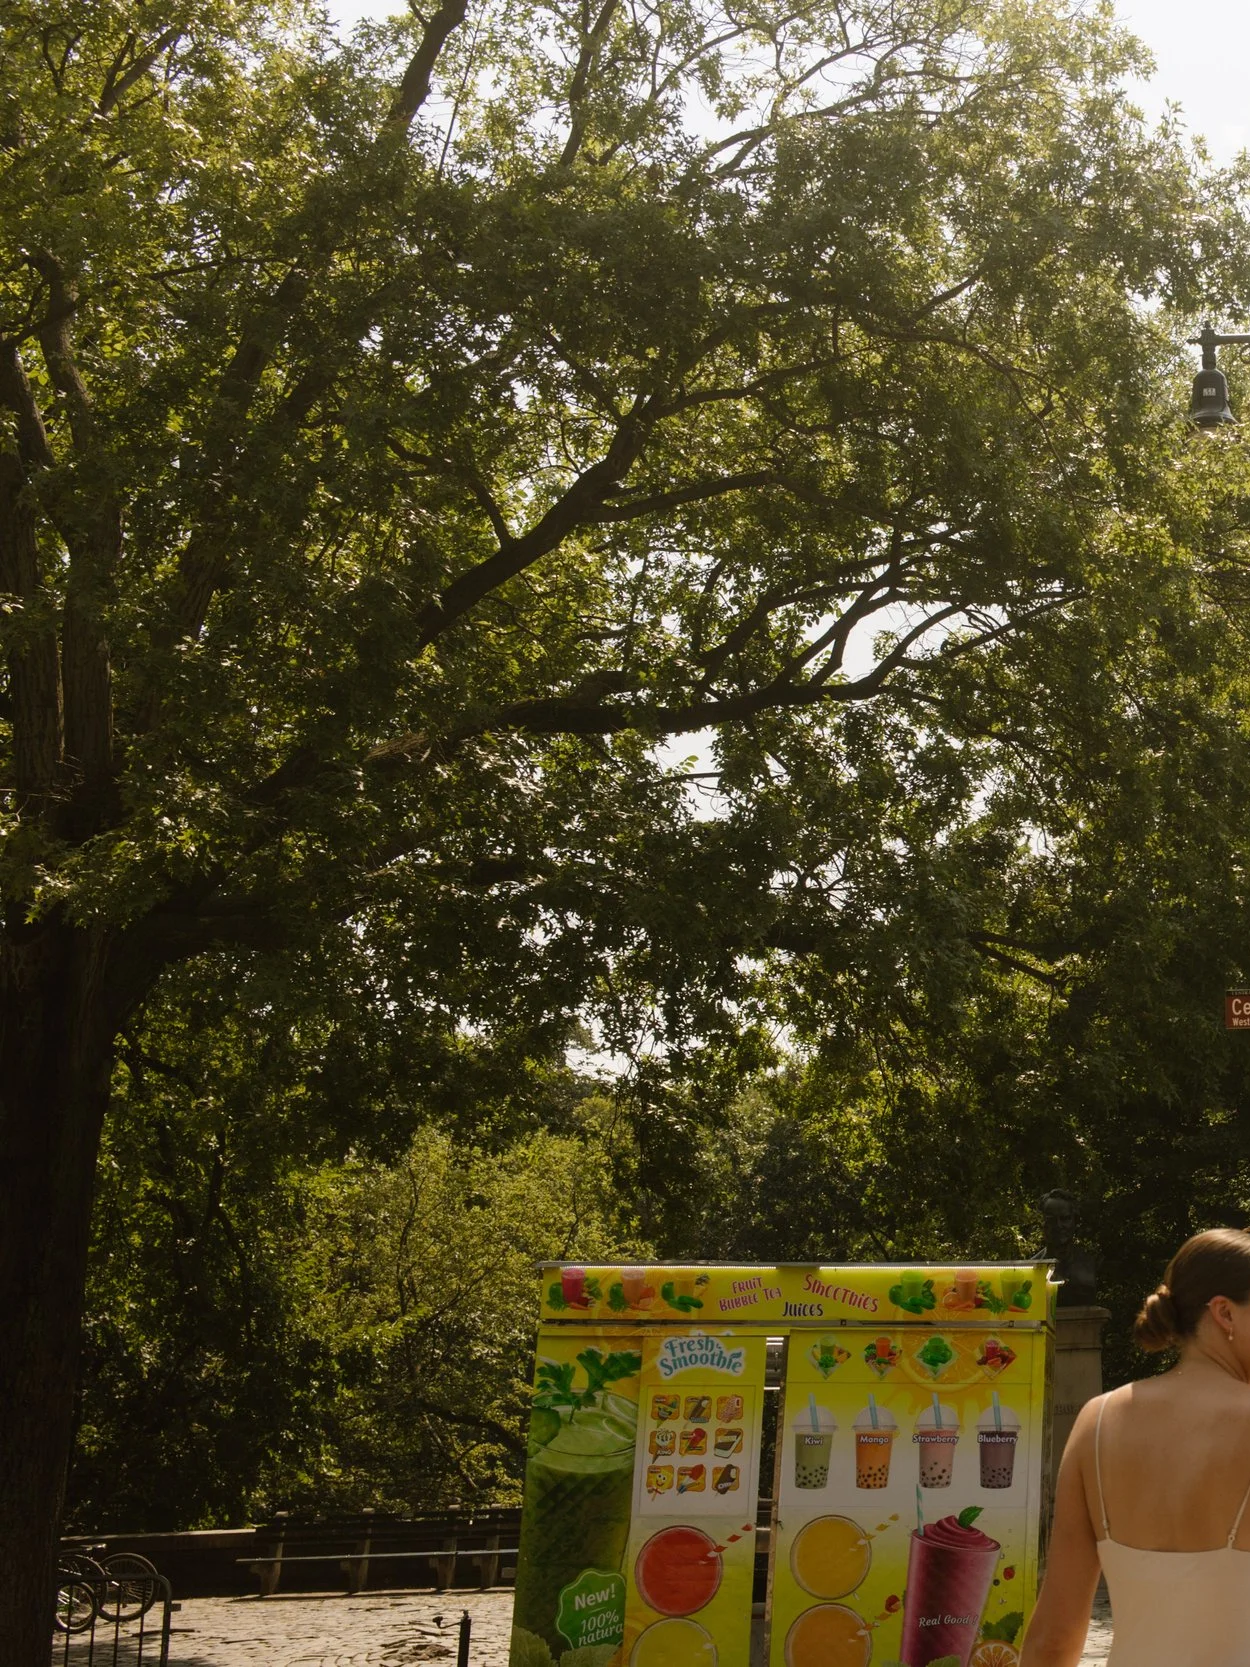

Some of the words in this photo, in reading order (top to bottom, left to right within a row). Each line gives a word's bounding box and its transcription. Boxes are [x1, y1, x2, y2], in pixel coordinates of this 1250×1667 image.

[1232, 1017, 1250, 1026] West
[664, 1336, 715, 1357] Fresh
[660, 1351, 742, 1376] Smoothie
[860, 1435, 889, 1444] Mango
[913, 1434, 958, 1444] Strawberry
[978, 1434, 1017, 1444] Blueberry
[575, 1583, 615, 1611] New!
[581, 1609, 619, 1633] 100%
[919, 1614, 941, 1628] Real
[943, 1614, 970, 1625] Good
